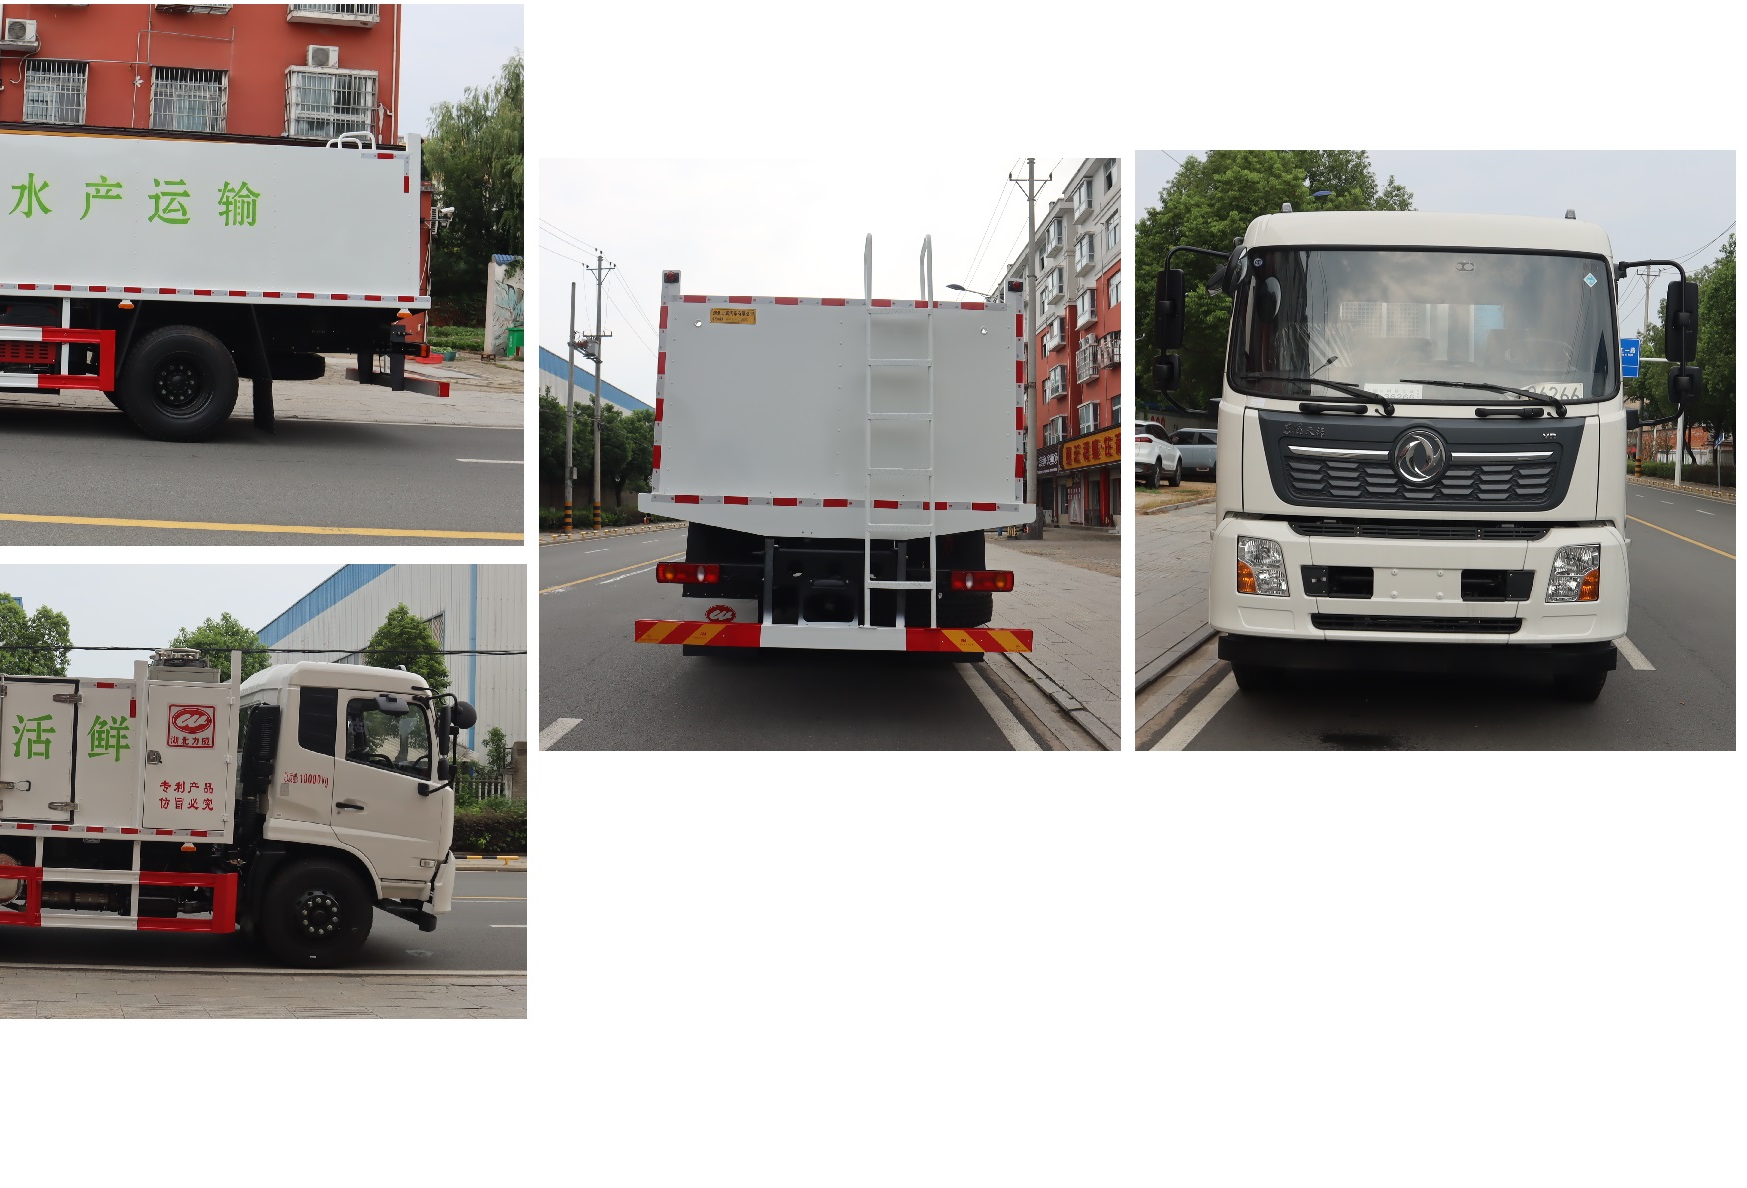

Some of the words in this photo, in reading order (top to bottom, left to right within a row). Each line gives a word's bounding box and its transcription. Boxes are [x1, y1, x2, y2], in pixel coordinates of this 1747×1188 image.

[170, 736, 211, 746] 湖北力威
[159, 780, 214, 794] 专利产品
[159, 797, 214, 811] 仿冒必究
